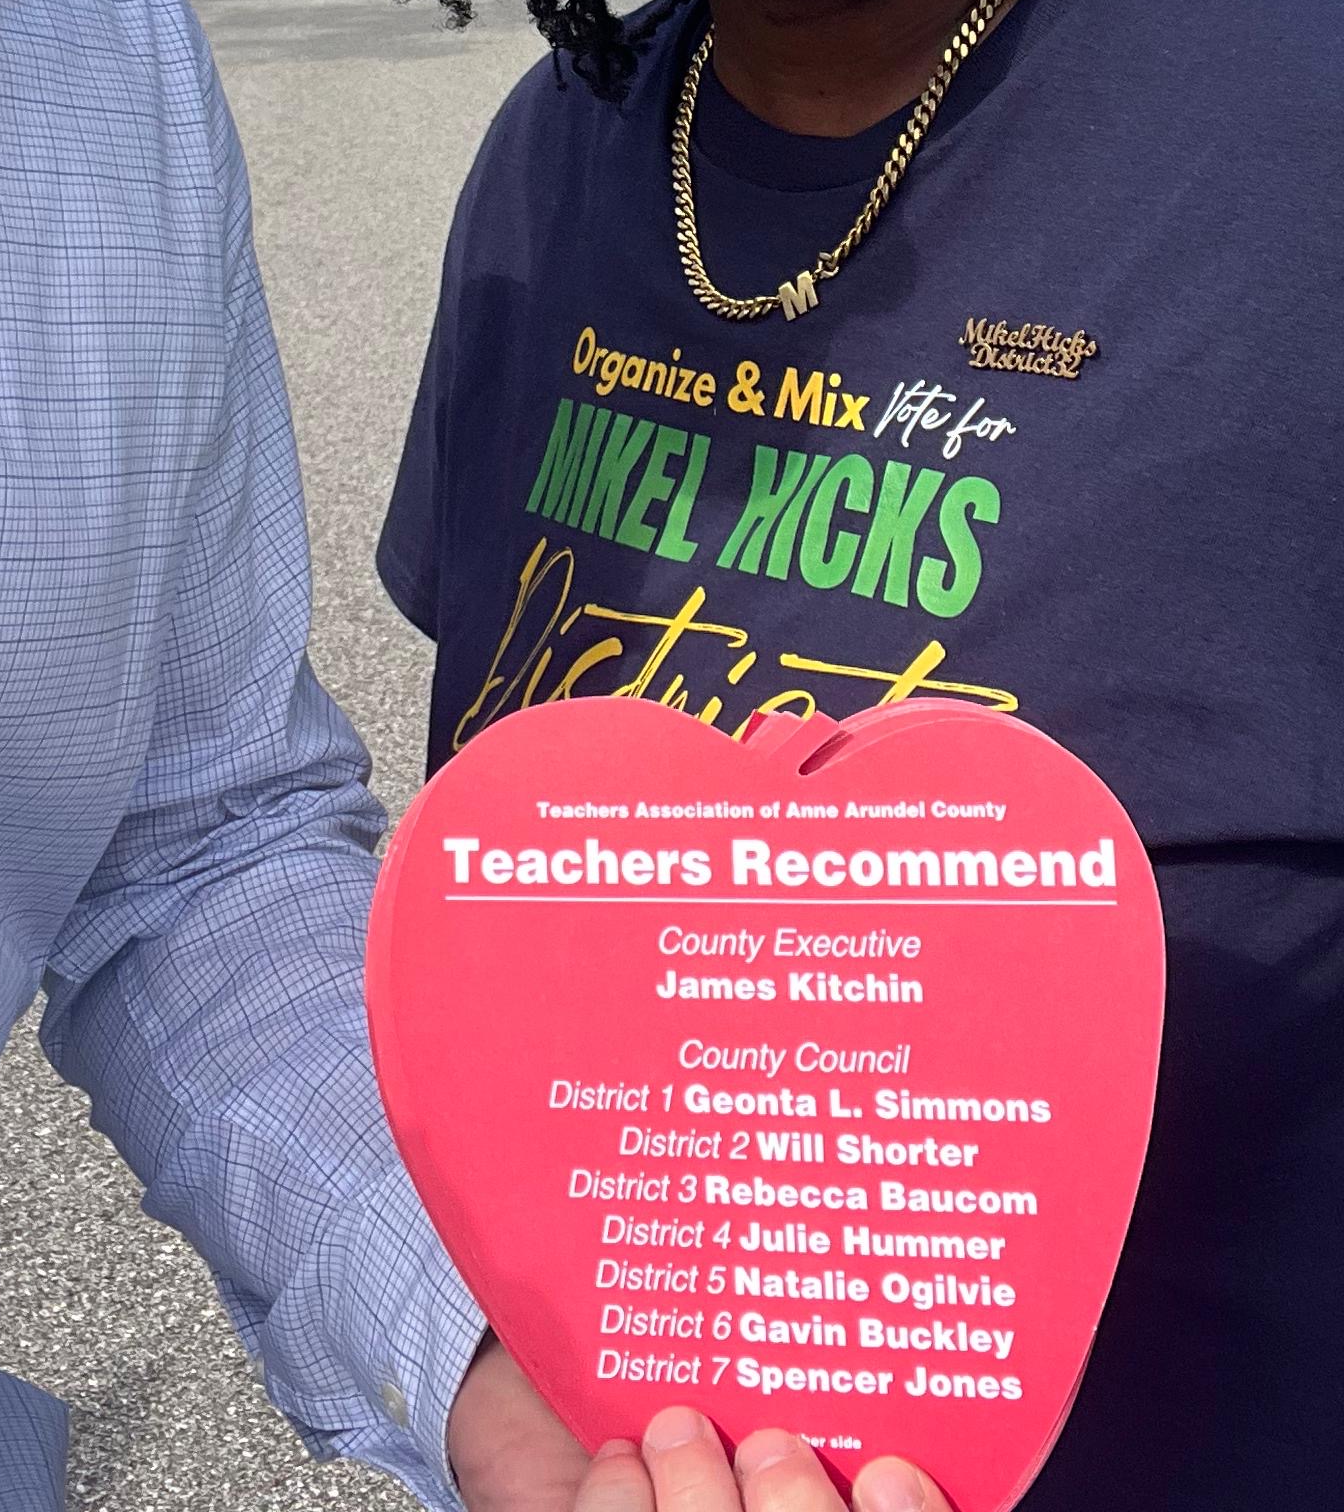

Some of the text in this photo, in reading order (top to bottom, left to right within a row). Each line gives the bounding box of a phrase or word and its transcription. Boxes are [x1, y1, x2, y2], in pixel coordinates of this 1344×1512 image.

[778, 270, 820, 322] M
[570, 326, 1017, 459] Organize & Mix Vote for
[524, 397, 1002, 619] MIKEL HICKS
[537, 800, 1007, 822] Teachers Association of Anne Arundel County
[443, 837, 1117, 888] Teachers Recommend
[658, 925, 922, 964] County Executive
[656, 969, 924, 1003] James Kitchin
[679, 1039, 911, 1078] County Council
[549, 1080, 1052, 1123] District 1 Geonta L. Simmons
[619, 1126, 979, 1168] District 2 Will Shorter
[568, 1169, 1038, 1215] District 3 Rebecca Baucom
[602, 1214, 1006, 1260] District 4 Julie Hummer
[595, 1259, 1016, 1311] District 5 Natalie Ogilvie
[600, 1303, 1015, 1360] District 6 Gavin Buckley
[596, 1349, 1024, 1400] District 7 Spencer Jones
[830, 1434, 862, 1449] side
